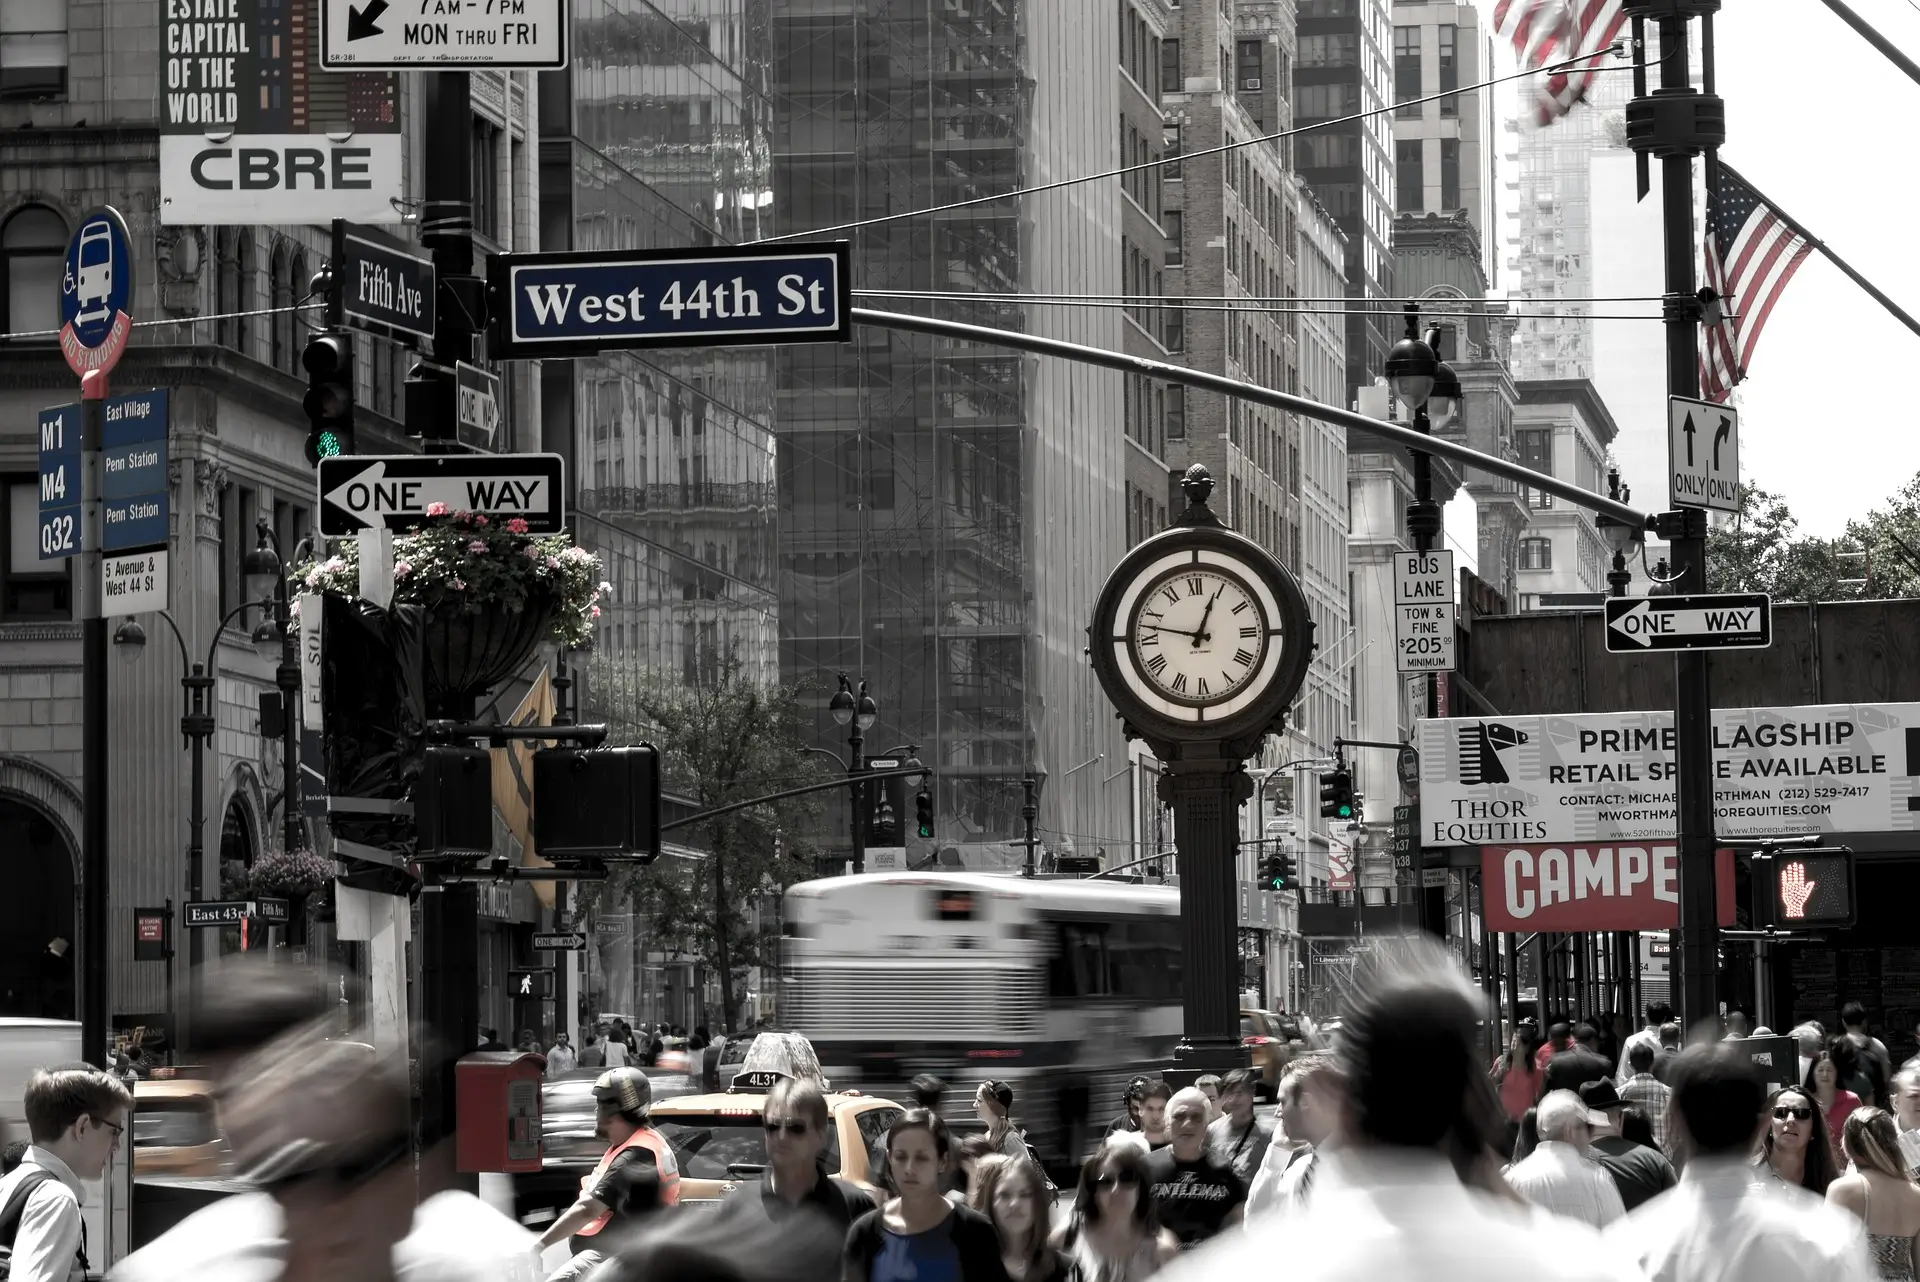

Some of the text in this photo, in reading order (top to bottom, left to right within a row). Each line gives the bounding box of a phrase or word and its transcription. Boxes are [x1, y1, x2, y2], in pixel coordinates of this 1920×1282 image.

[168, 0, 239, 18] ESTATE
[168, 23, 250, 53] CAPITAL
[404, 23, 537, 45] MON THRU FRI
[330, 54, 356, 62] SR-381
[168, 58, 236, 88] OF THE
[168, 93, 238, 123] WORLD
[190, 148, 372, 190] CBRE
[359, 259, 422, 318] Fifth Ave
[524, 274, 825, 325] West 44th St
[63, 320, 123, 369] NO STANDING
[106, 400, 151, 421] East Village
[460, 389, 498, 430] ONE WAY
[42, 414, 63, 451] M1
[106, 451, 158, 472] Penn Station
[42, 465, 66, 502] M4
[1675, 472, 1737, 502] ONLY ONLY
[347, 481, 540, 511] ONE WAY
[106, 502, 159, 524] Penn Station
[42, 514, 73, 555] Q32
[105, 556, 155, 578] 5 Avenue &
[1408, 557, 1439, 575] BUS
[105, 576, 154, 597] West 44 St
[1404, 581, 1444, 598] LANE
[1405, 607, 1445, 619] TOW &
[1624, 610, 1755, 634] ONE WAY
[1412, 622, 1438, 634] FINE
[308, 621, 321, 666] SOL
[1407, 658, 1446, 667] MINIMUM
[1580, 721, 1854, 753] PRIME LAGSHIP
[1550, 755, 1887, 784] RETAIL SPE AVAILABLE
[1559, 787, 1870, 806] CONTACT: MICHAE RTHMAN (212) 529-7417
[1451, 799, 1528, 819] THOR
[1598, 805, 1831, 821] MWORTHMAHOREQUITIES.COM
[1432, 821, 1547, 844] EQUITIES
[1610, 829, 1677, 839] www.520fifthav
[1727, 825, 1821, 835] www.thorequities.com
[1504, 846, 1679, 919] CAMPE
[192, 908, 220, 920] East
[262, 902, 284, 917] Fifth Ave
[537, 937, 579, 946] ONE WAY
[750, 1073, 776, 1086] 4L31
